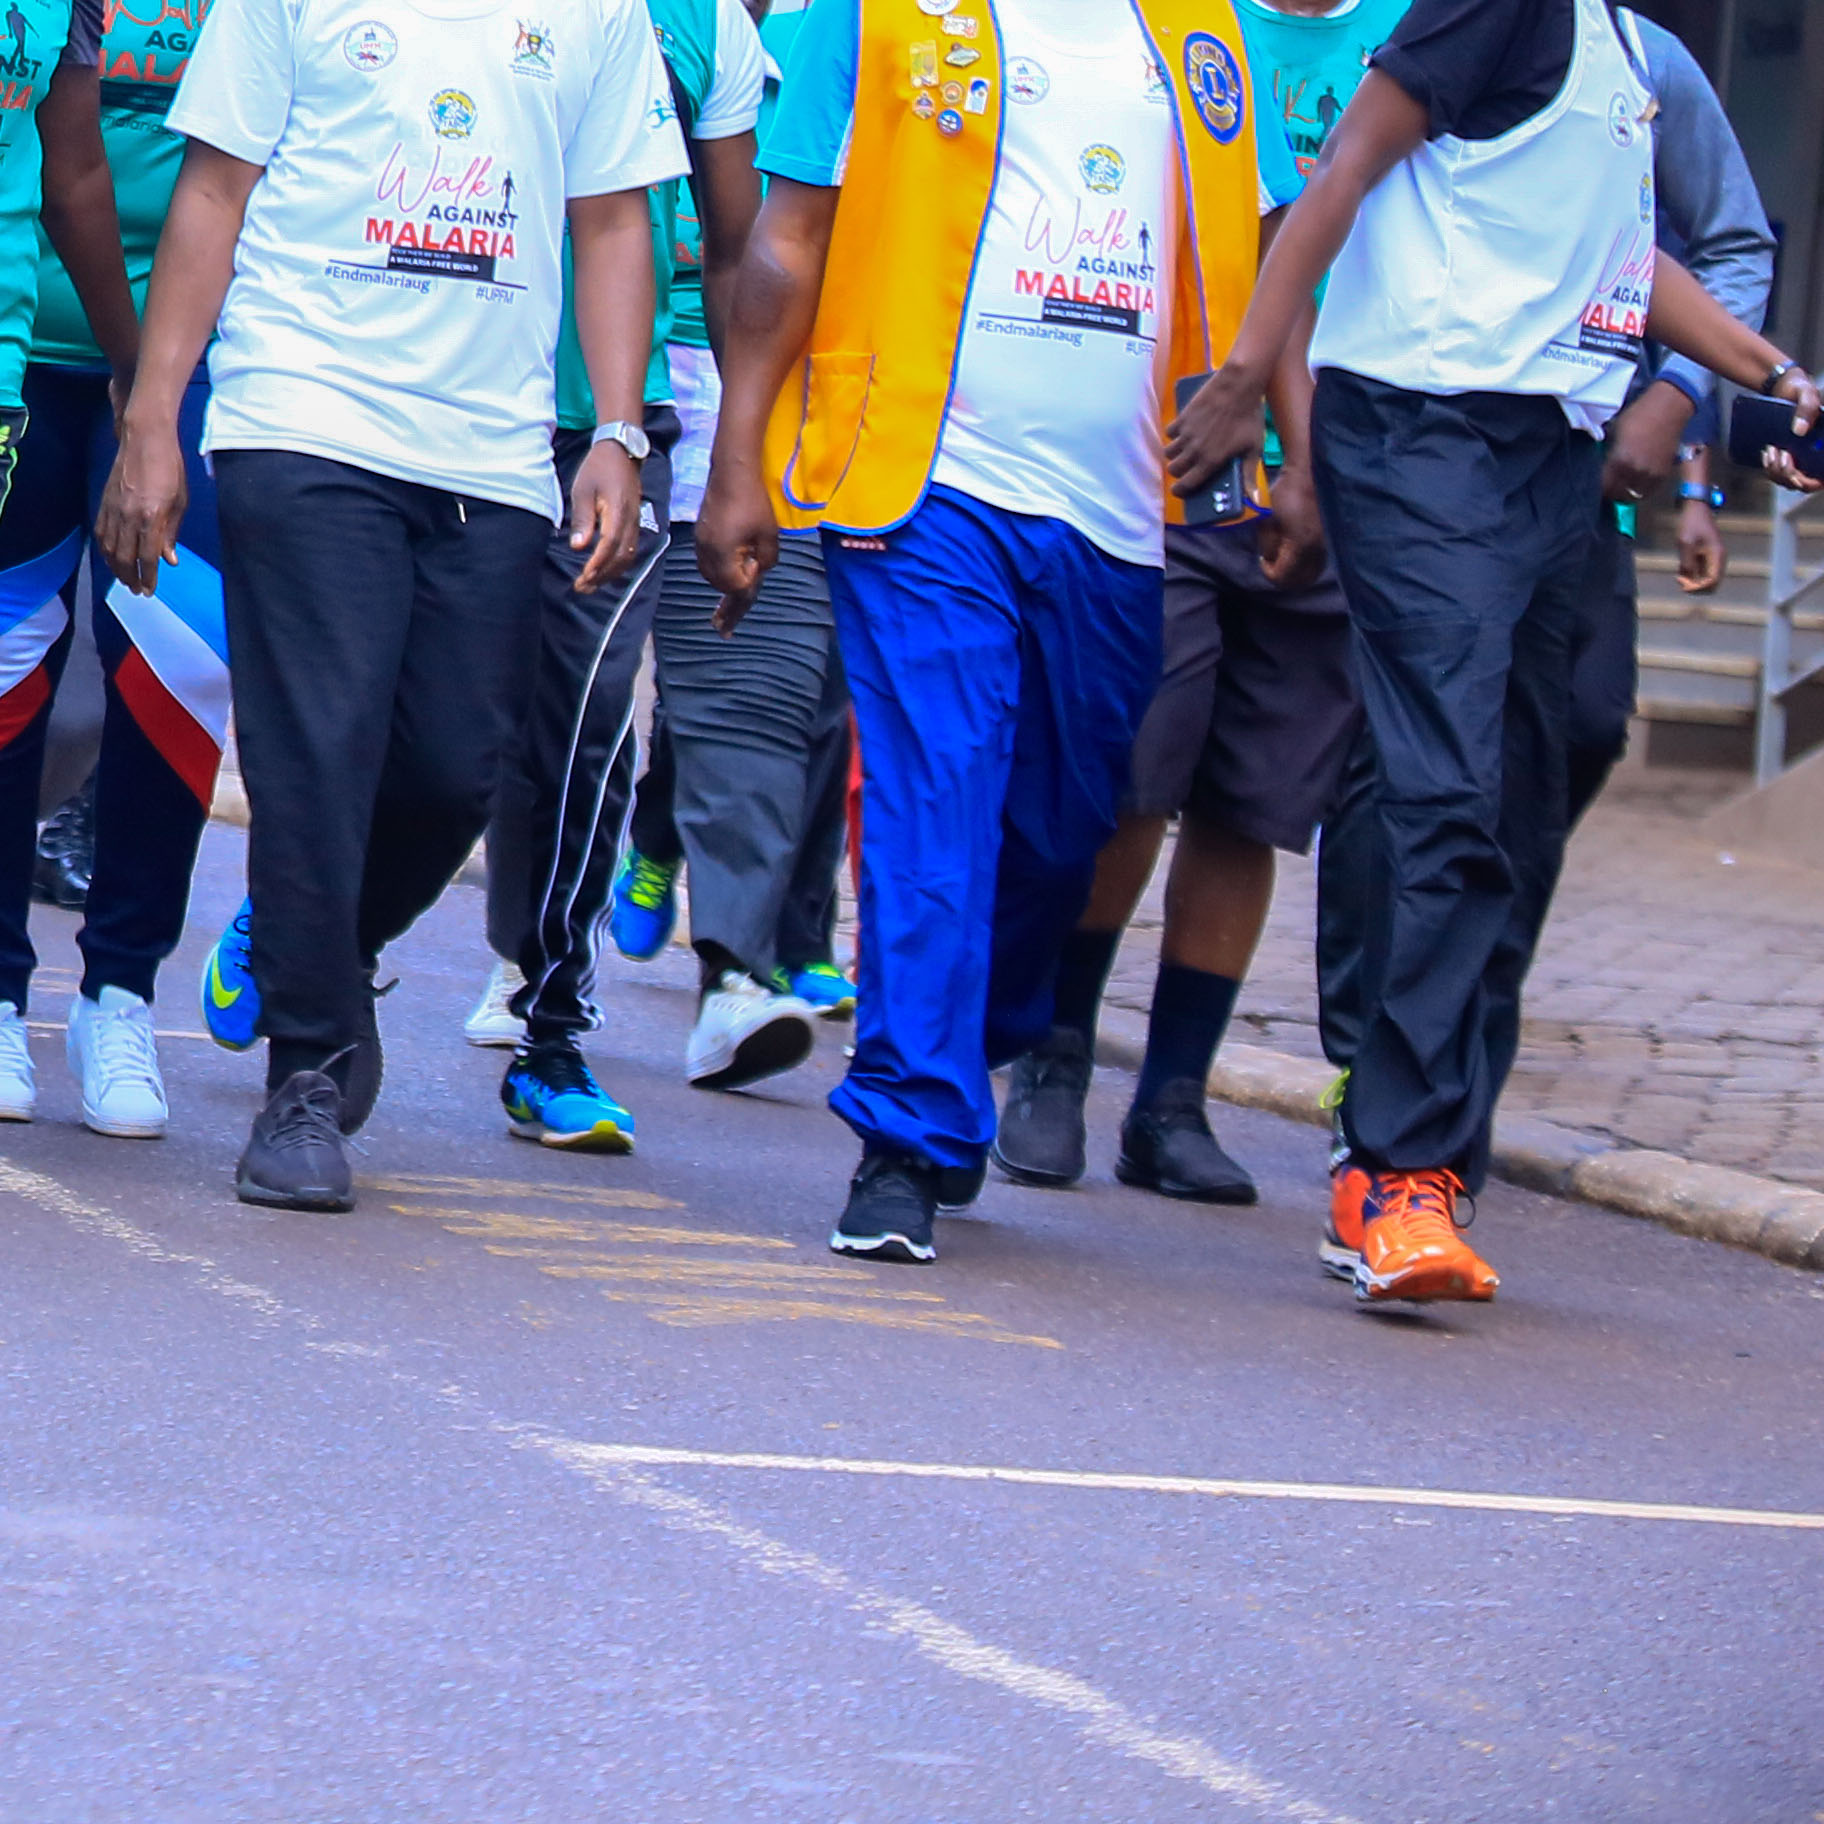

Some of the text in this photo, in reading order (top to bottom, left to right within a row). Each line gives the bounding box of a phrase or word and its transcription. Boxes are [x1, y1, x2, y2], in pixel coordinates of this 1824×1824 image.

[376, 142, 495, 213] Walk
[426, 204, 520, 231] AGAINST
[1025, 193, 1131, 264] Walk
[364, 217, 516, 259] MALARIA
[390, 256, 396, 264] A
[452, 262, 479, 273] WORLD
[1076, 255, 1156, 282] AGAINST
[324, 265, 514, 305] #Endmalariaug #UPFM
[1015, 269, 1156, 314] MALARIA
[976, 320, 1084, 347] #Endmalariaug
